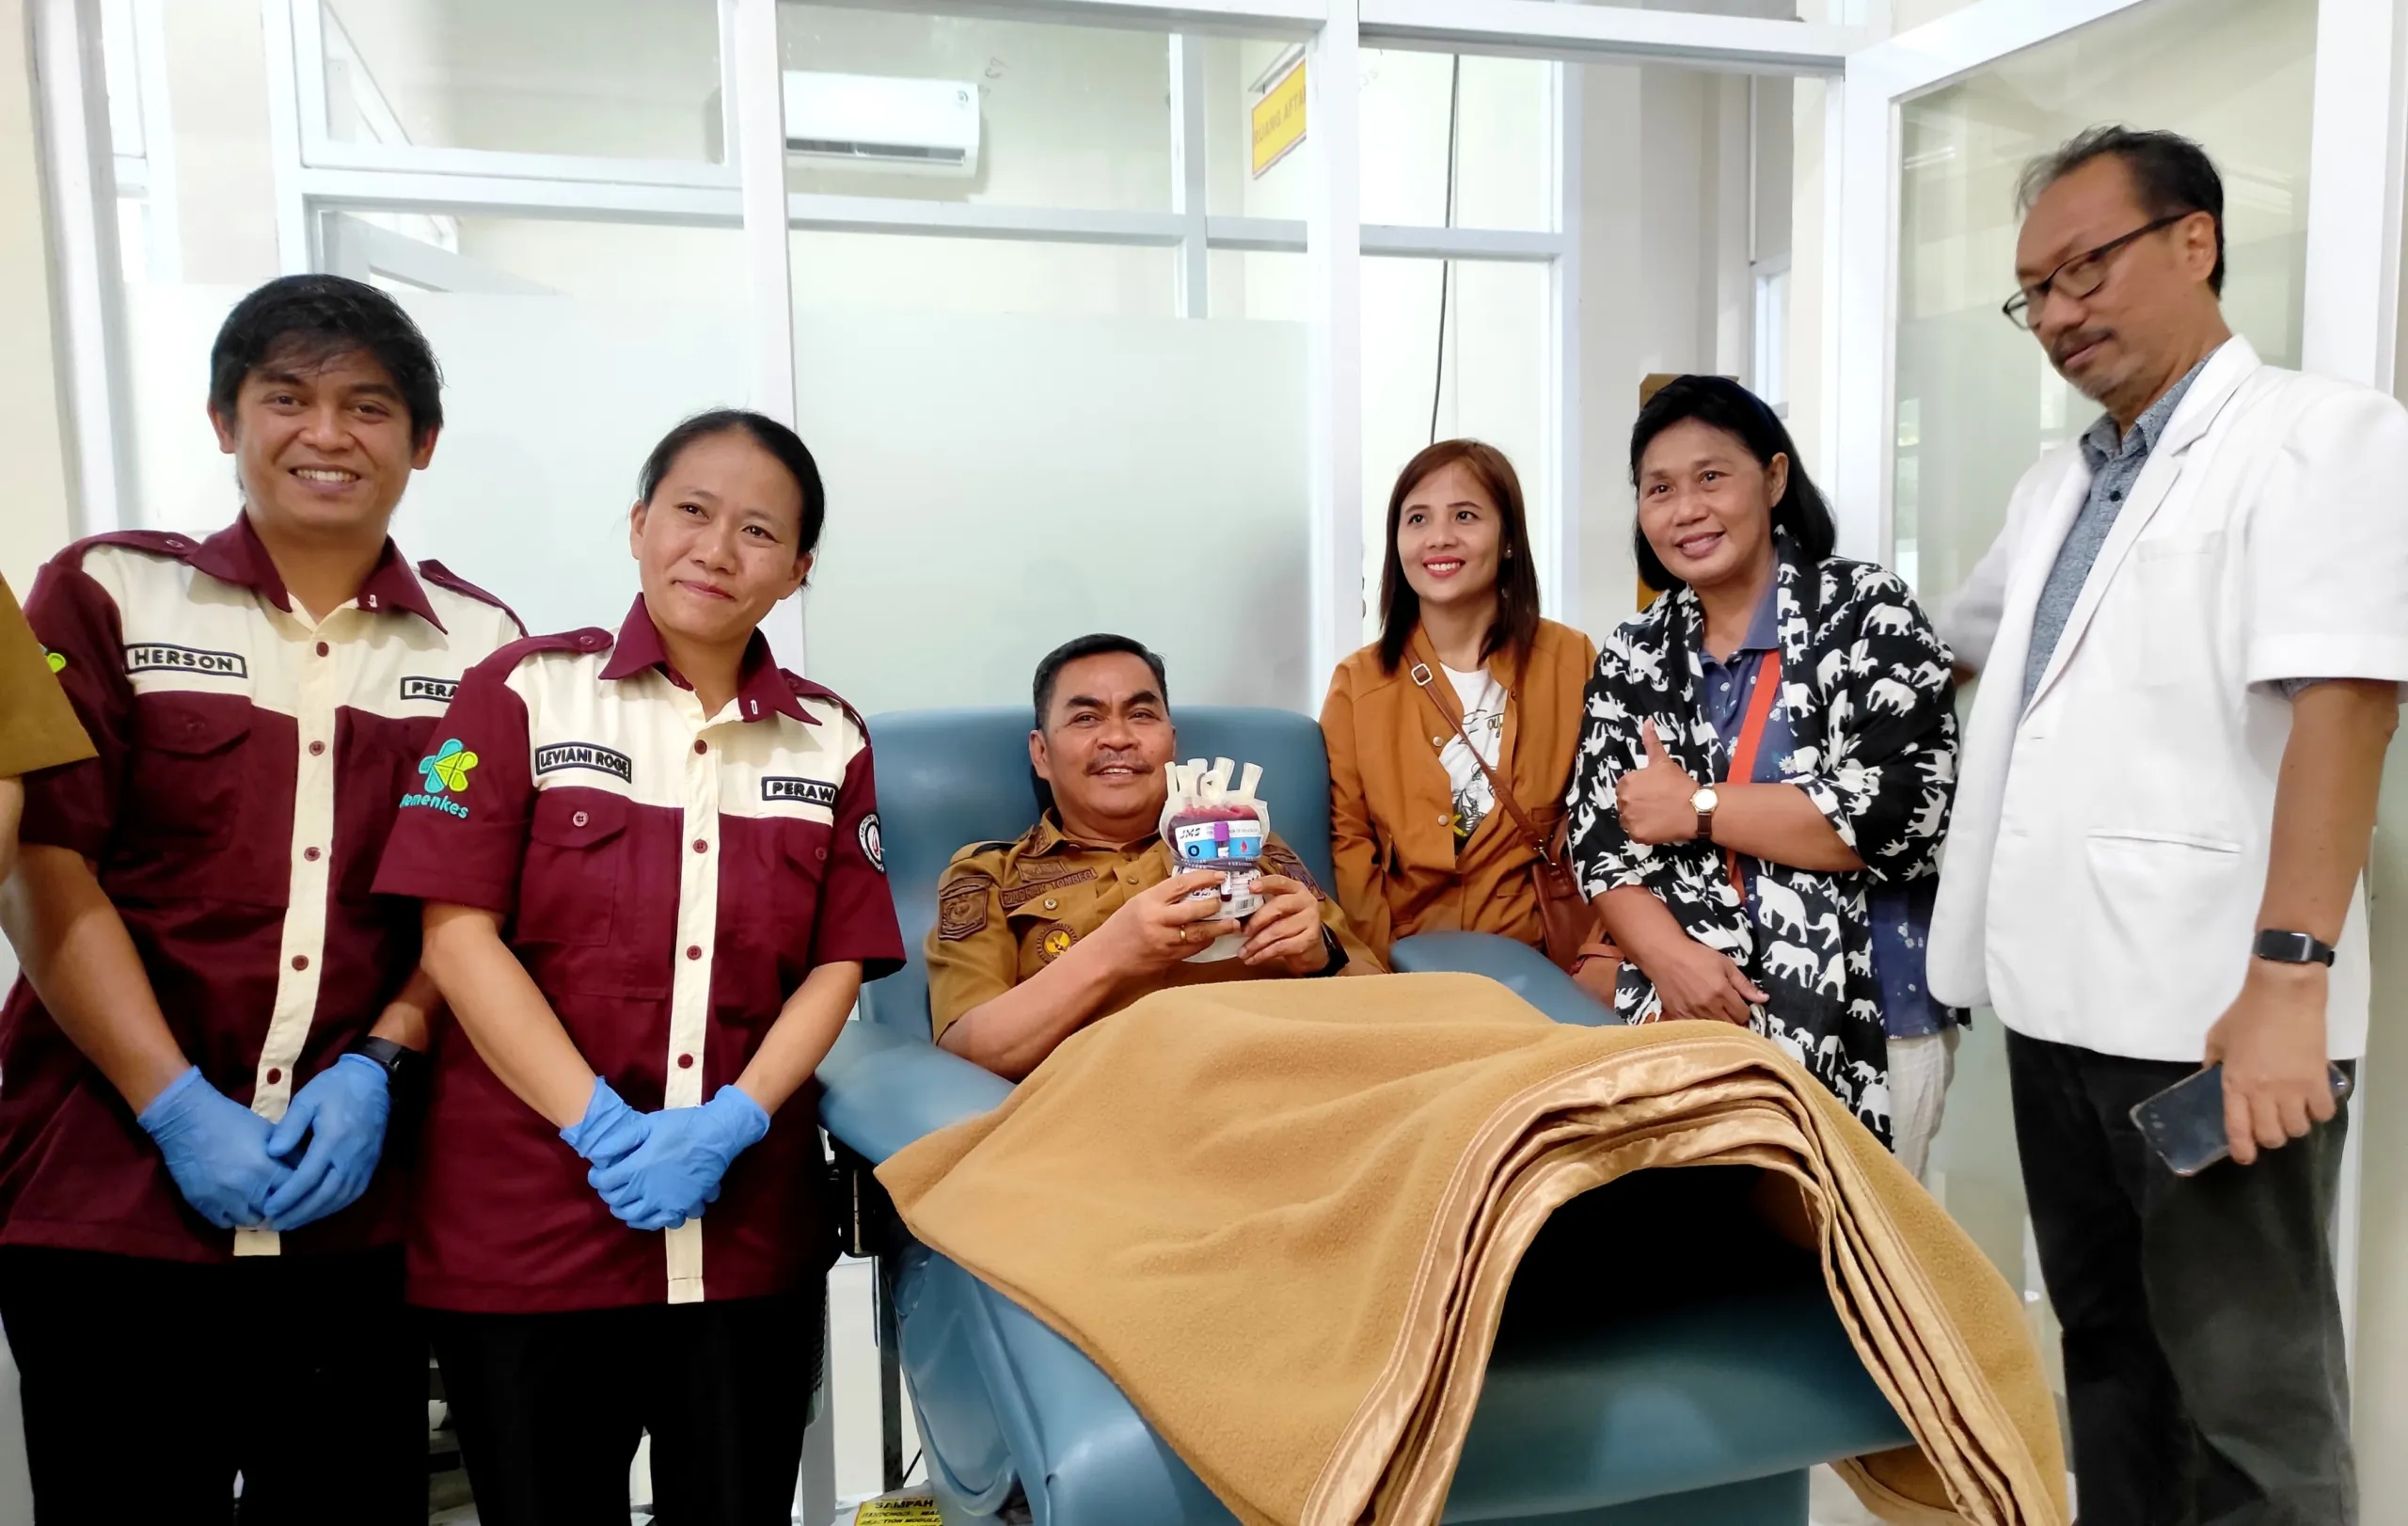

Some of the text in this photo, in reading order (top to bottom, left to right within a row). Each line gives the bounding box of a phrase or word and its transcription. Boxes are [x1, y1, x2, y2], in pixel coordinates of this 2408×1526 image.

[135, 648, 233, 671] HERSON
[541, 748, 592, 767] LEVIANI
[772, 782, 834, 803] PERAW
[875, 1499, 934, 1509] SAMPAH
